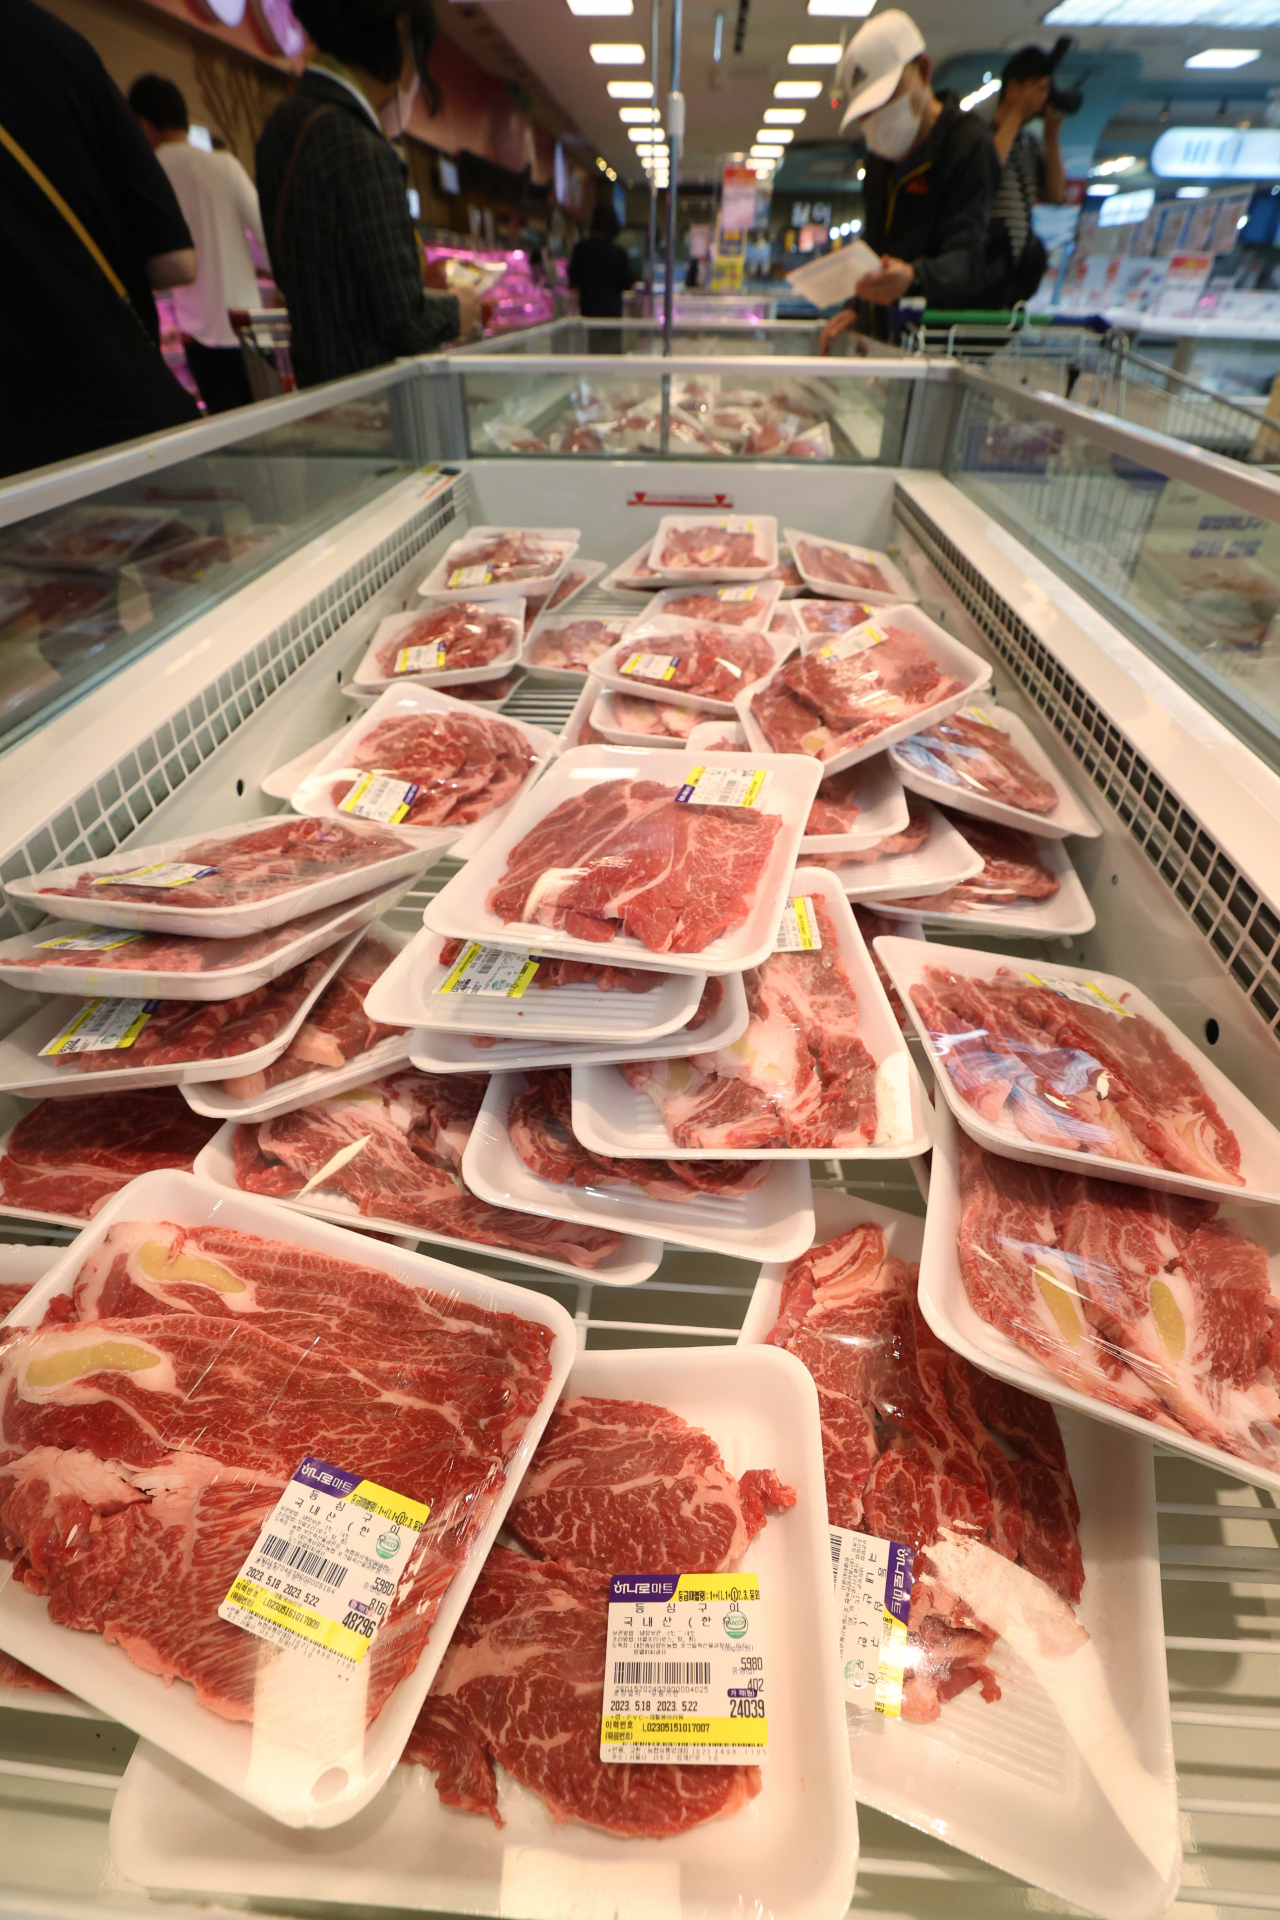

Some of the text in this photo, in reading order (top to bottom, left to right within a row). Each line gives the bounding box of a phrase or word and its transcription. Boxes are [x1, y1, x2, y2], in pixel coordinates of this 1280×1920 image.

[301, 1463, 353, 1491] 하나로마트
[371, 1576, 394, 1596] 5980
[613, 1580, 673, 1593] 하나로마트
[890, 1547, 907, 1614] 하나로마트
[233, 1581, 260, 1598] 이력번호
[367, 1598, 386, 1615] 816
[340, 1609, 376, 1638] 48796
[740, 1657, 762, 1670] 5980
[747, 1678, 763, 1691] 402
[610, 1701, 697, 1711] 2023. 5.18 2023. 5.22
[729, 1699, 765, 1718] 24039
[605, 1721, 710, 1732] 이력번호 L02305151017007
[604, 1731, 633, 1740] (묶음번호)
